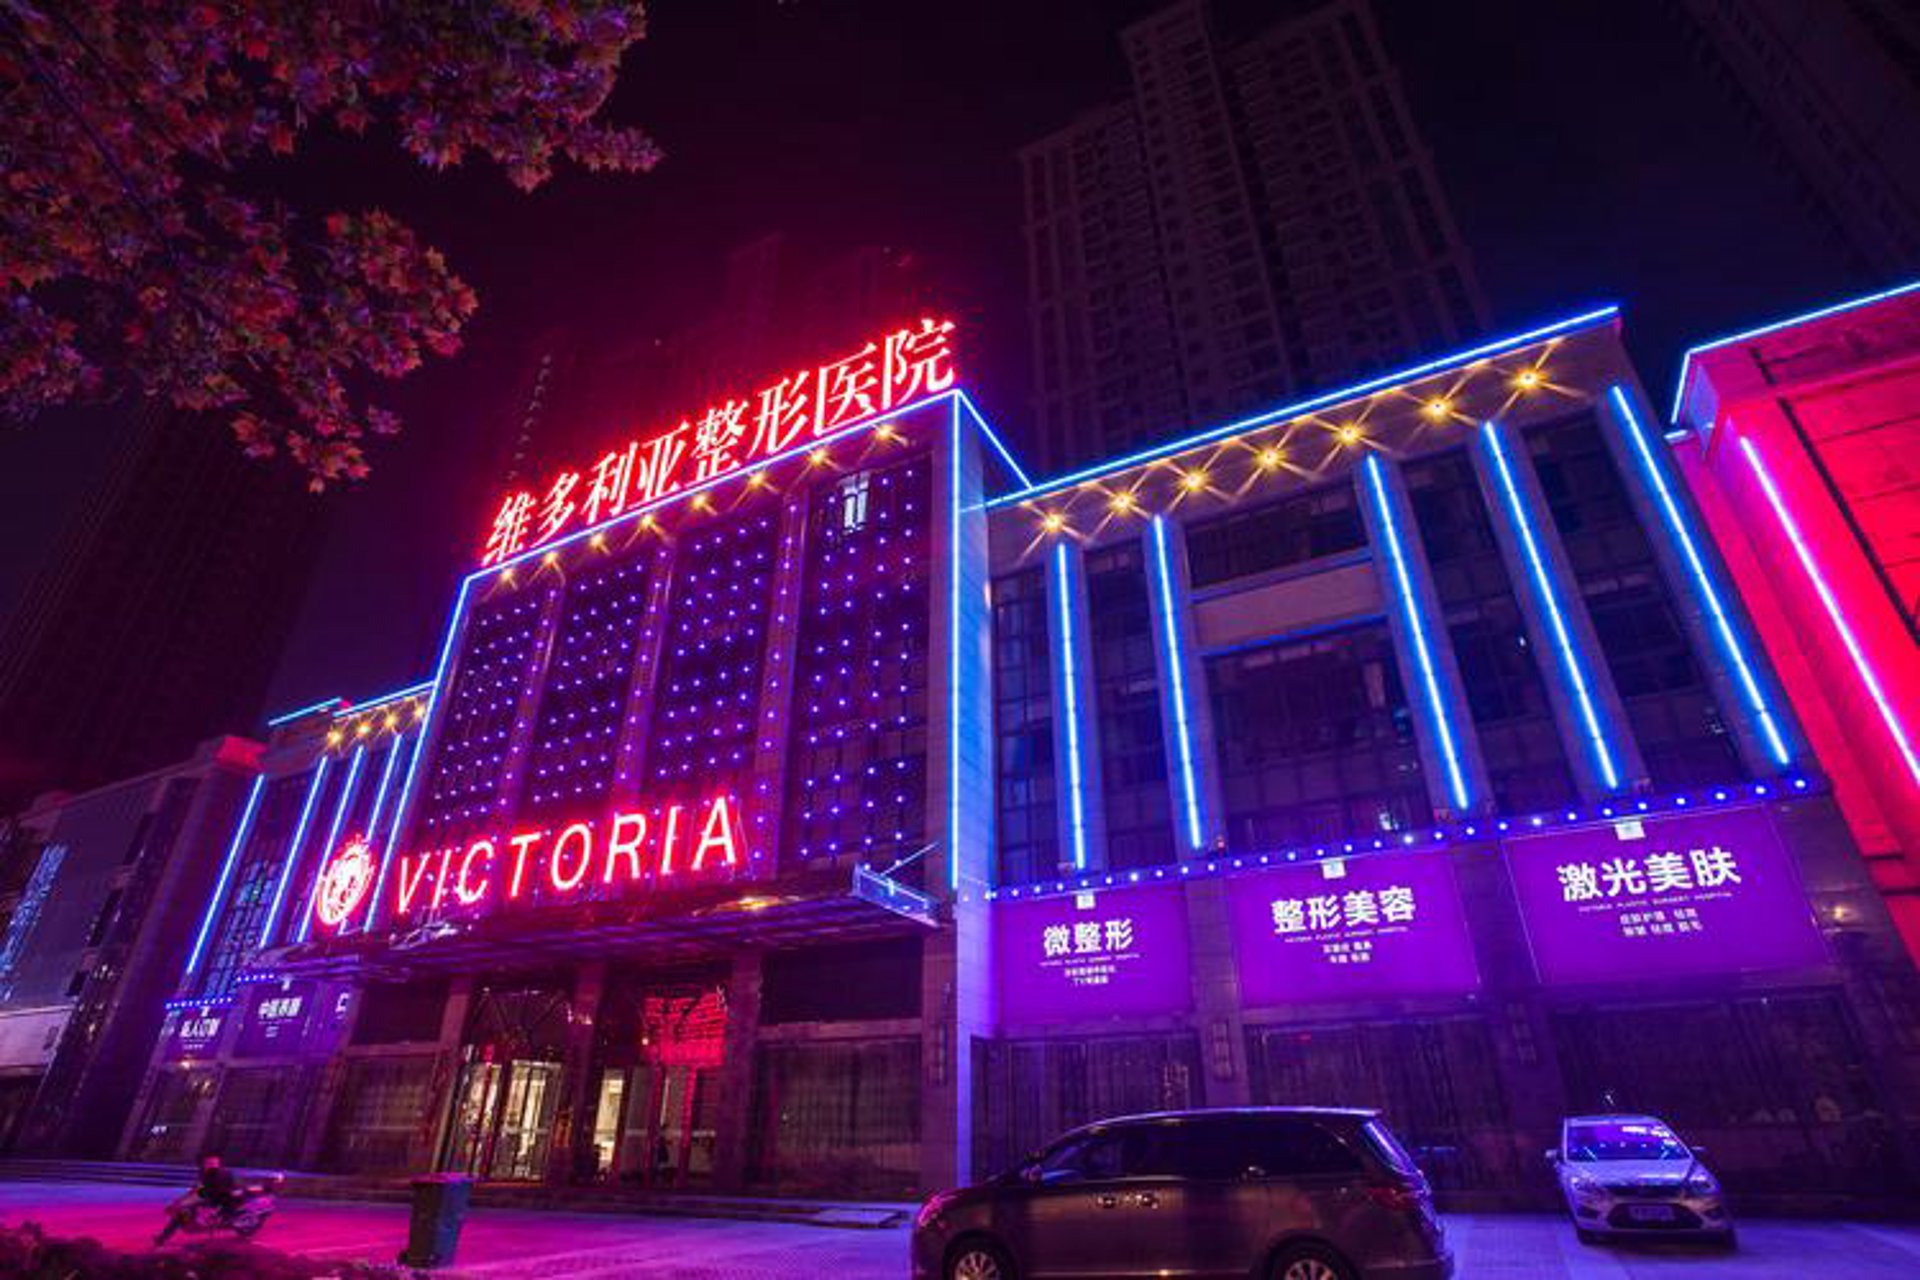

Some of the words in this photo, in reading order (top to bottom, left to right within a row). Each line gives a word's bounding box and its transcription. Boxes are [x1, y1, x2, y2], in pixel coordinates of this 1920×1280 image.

[481, 318, 956, 564] 维多利亚整形医院
[398, 797, 737, 913] VICTORIA
[1556, 847, 1742, 901] 激光美肤
[1271, 885, 1416, 933] 整形美容
[1044, 918, 1133, 957] 微整形
